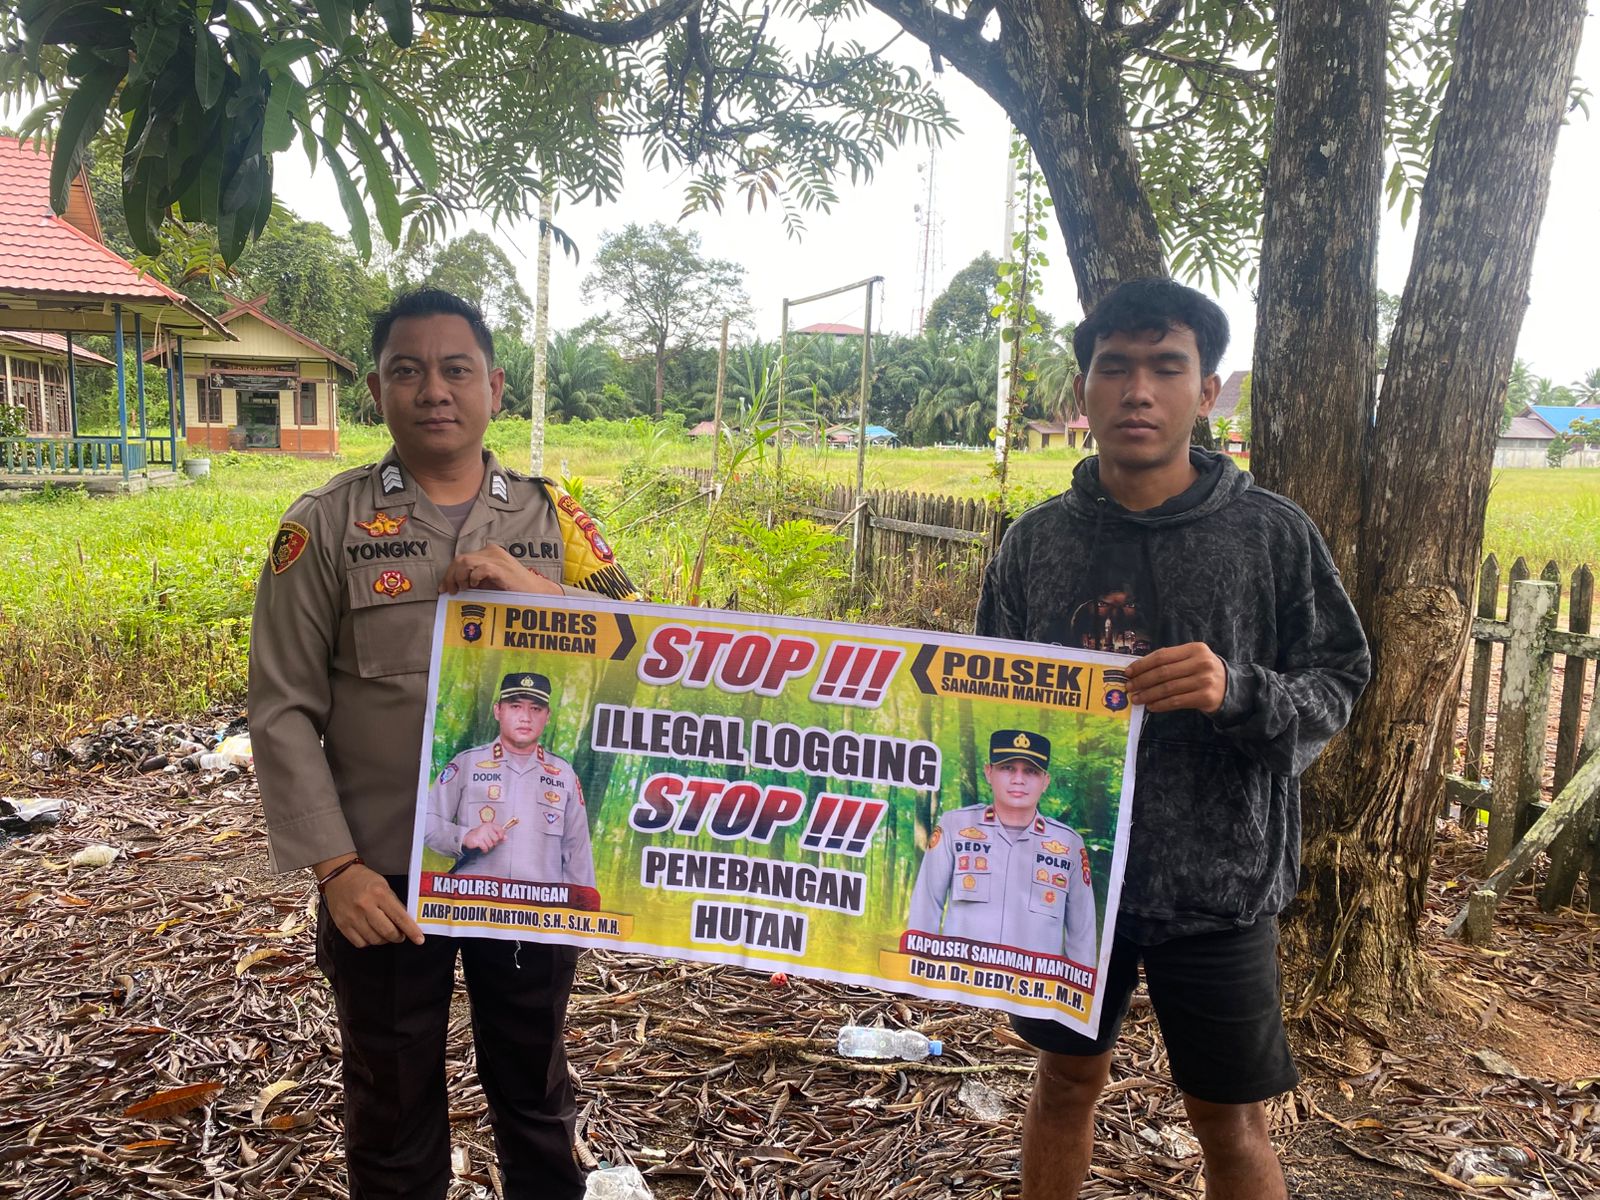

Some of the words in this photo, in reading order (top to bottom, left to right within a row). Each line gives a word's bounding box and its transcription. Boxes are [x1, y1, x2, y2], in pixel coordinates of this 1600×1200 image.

[347, 541, 428, 563] YONGKY
[500, 542, 559, 559] OLRI
[505, 608, 597, 636] POLRES
[504, 631, 597, 655] KATINGAN
[642, 627, 814, 692] STOP
[816, 645, 901, 702] !!!
[942, 651, 1084, 692] POLSEK
[941, 678, 1010, 699] SANAMAN
[1012, 685, 1082, 708] MANTIKEI
[595, 707, 745, 762] ILLEGAL
[755, 725, 939, 786] LOGGING
[473, 773, 502, 782] DODIK
[540, 775, 565, 788] POLRI
[633, 776, 803, 840] STOP
[804, 796, 885, 852] !!!
[955, 842, 991, 854] DEDY
[1036, 854, 1071, 871] POLRI
[432, 876, 499, 898] KAPOLRES
[502, 883, 569, 903] KATINGAN
[645, 850, 863, 911] PENEBANGAN
[422, 903, 452, 919] AKBP
[453, 906, 489, 922] DODIK
[489, 908, 541, 928] HARTONO,
[598, 919, 620, 936] M.H.
[695, 904, 805, 952] HUTAN
[907, 934, 969, 960] KAPOLSEK
[971, 945, 1033, 973] SANAMAN
[1035, 957, 1093, 989] MANTIKEI
[910, 959, 946, 981] IPDA
[950, 966, 970, 984] Dr.
[973, 970, 1015, 994] DEDY,
[1018, 980, 1052, 1001] S.H.,
[1055, 988, 1086, 1012] M.H.
